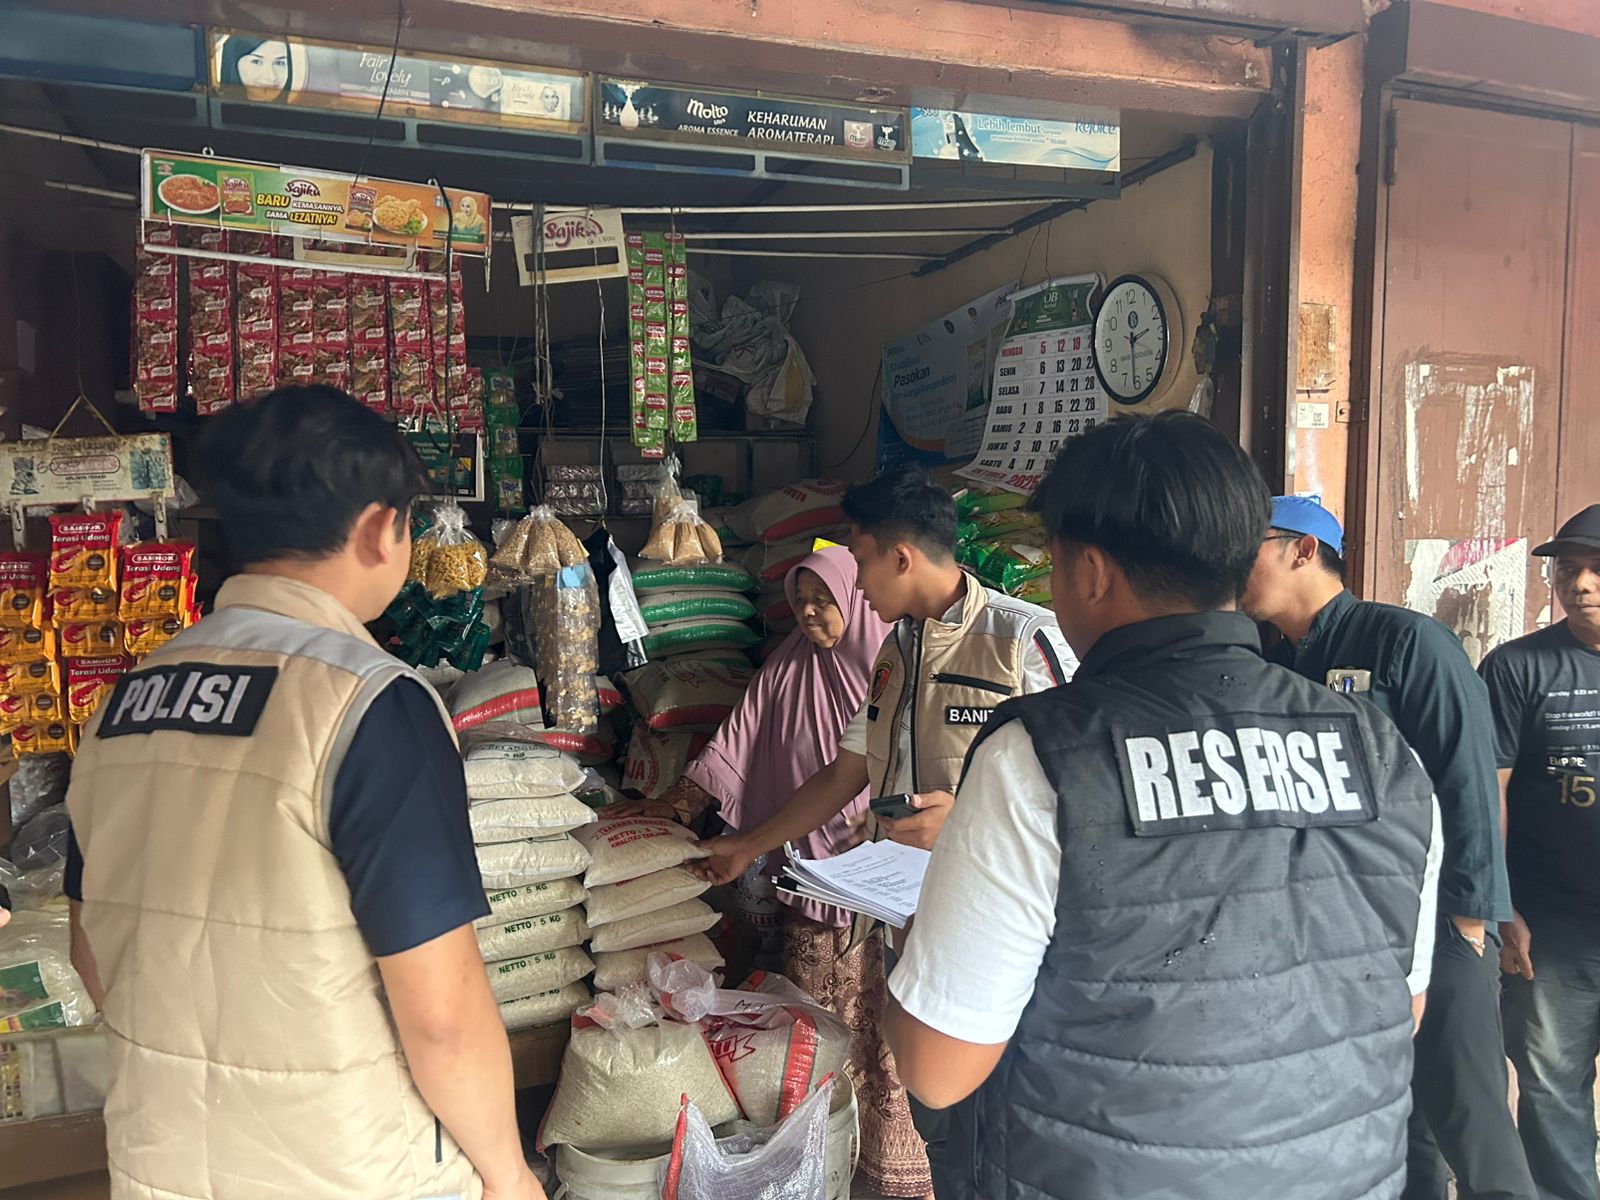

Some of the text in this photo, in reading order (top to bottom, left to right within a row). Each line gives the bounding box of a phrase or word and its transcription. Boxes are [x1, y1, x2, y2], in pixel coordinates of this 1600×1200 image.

[360, 52, 388, 68] Fair
[370, 69, 412, 88] Lovely
[686, 98, 729, 120] Molto
[747, 110, 828, 131] KEHARUMAN
[978, 118, 1005, 132] Lebih
[1007, 120, 1042, 134] lembut
[678, 124, 739, 137] AROMA ESSENCE
[747, 126, 835, 146] AROMATERAPI
[285, 181, 321, 198] Sajiku
[256, 193, 345, 213] BARU KEMASANNYA,
[265, 211, 337, 225] SAMA LEZATNYA!
[1126, 288, 1136, 304] 12
[1115, 299, 1123, 314] 11
[1152, 304, 1160, 320] 2
[1040, 341, 1046, 355] 5
[1057, 339, 1065, 353] 12
[1073, 336, 1081, 351] 19
[1104, 338, 1113, 353] 9
[999, 366, 1017, 377] SENIN
[1039, 361, 1046, 375] 6
[1056, 359, 1065, 373] 13
[1071, 357, 1081, 371] 20
[1110, 358, 1118, 373] 8
[894, 366, 930, 388] Pasokan
[1121, 372, 1129, 388] 7
[1145, 367, 1153, 382] 5
[998, 376, 1095, 396] SELASA 7 14 21 28
[1133, 375, 1141, 390] 6
[995, 397, 1095, 415] RABU 1 8 15 22 29
[991, 423, 1013, 433] KAMIS
[1018, 421, 1026, 434] 2
[1035, 421, 1042, 434] 9
[1052, 420, 1061, 434] 16
[1068, 419, 1079, 433] 23
[1013, 440, 1021, 452] 3
[1031, 440, 1042, 453] 10
[1049, 440, 1059, 453] 17
[979, 459, 1002, 468] SABTU
[1008, 458, 1016, 470] 4
[1025, 458, 1035, 471] 11
[52, 533, 110, 543] Terasi Udang
[126, 564, 181, 572] Terasi Udang
[70, 668, 97, 676] Terasi
[111, 671, 251, 726] POLISI
[1124, 727, 1362, 822] RESERSE
[1557, 774, 1596, 808] 15
[607, 829, 636, 842] NETTO
[526, 886, 532, 894] 5
[535, 883, 548, 891] KG
[549, 914, 561, 923] KG
[544, 952, 556, 961] KG
